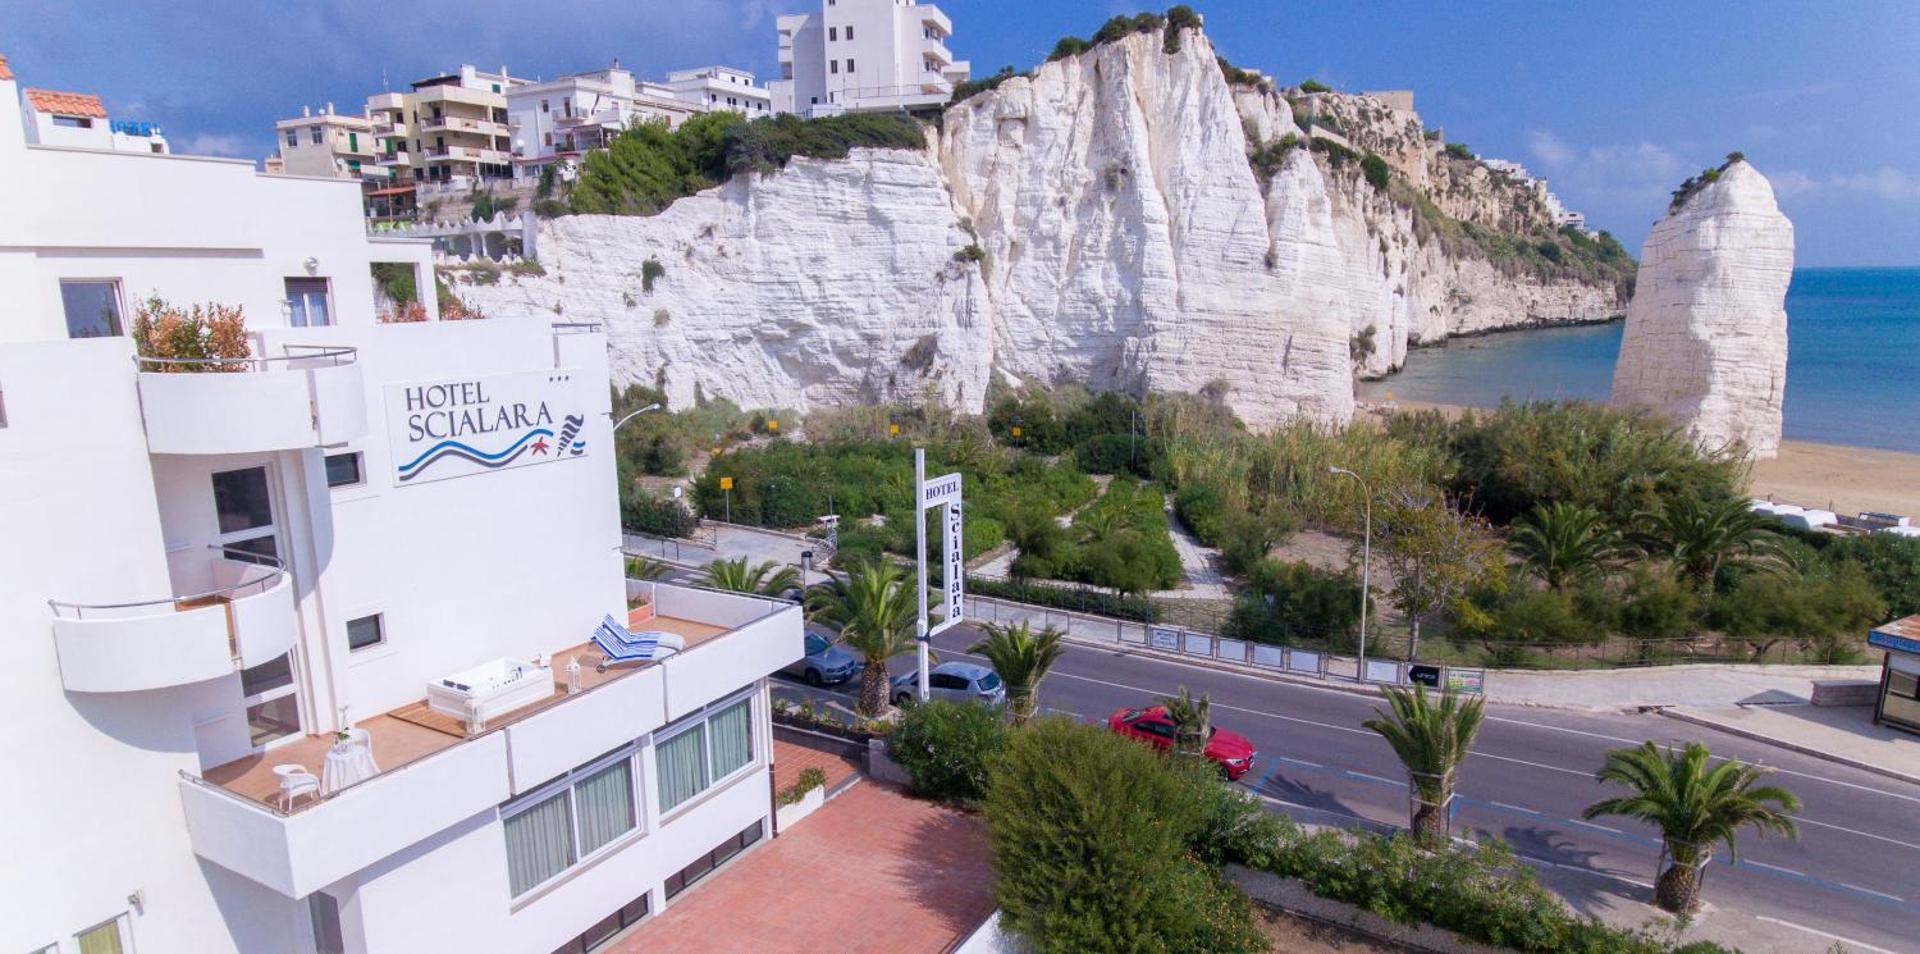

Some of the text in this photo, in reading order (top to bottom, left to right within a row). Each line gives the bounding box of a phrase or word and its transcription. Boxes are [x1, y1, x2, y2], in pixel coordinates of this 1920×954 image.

[405, 381, 490, 412] HOTEL
[408, 401, 553, 442] SCIALARA
[926, 481, 959, 500] HOTEL
[950, 503, 961, 618] Scialara
